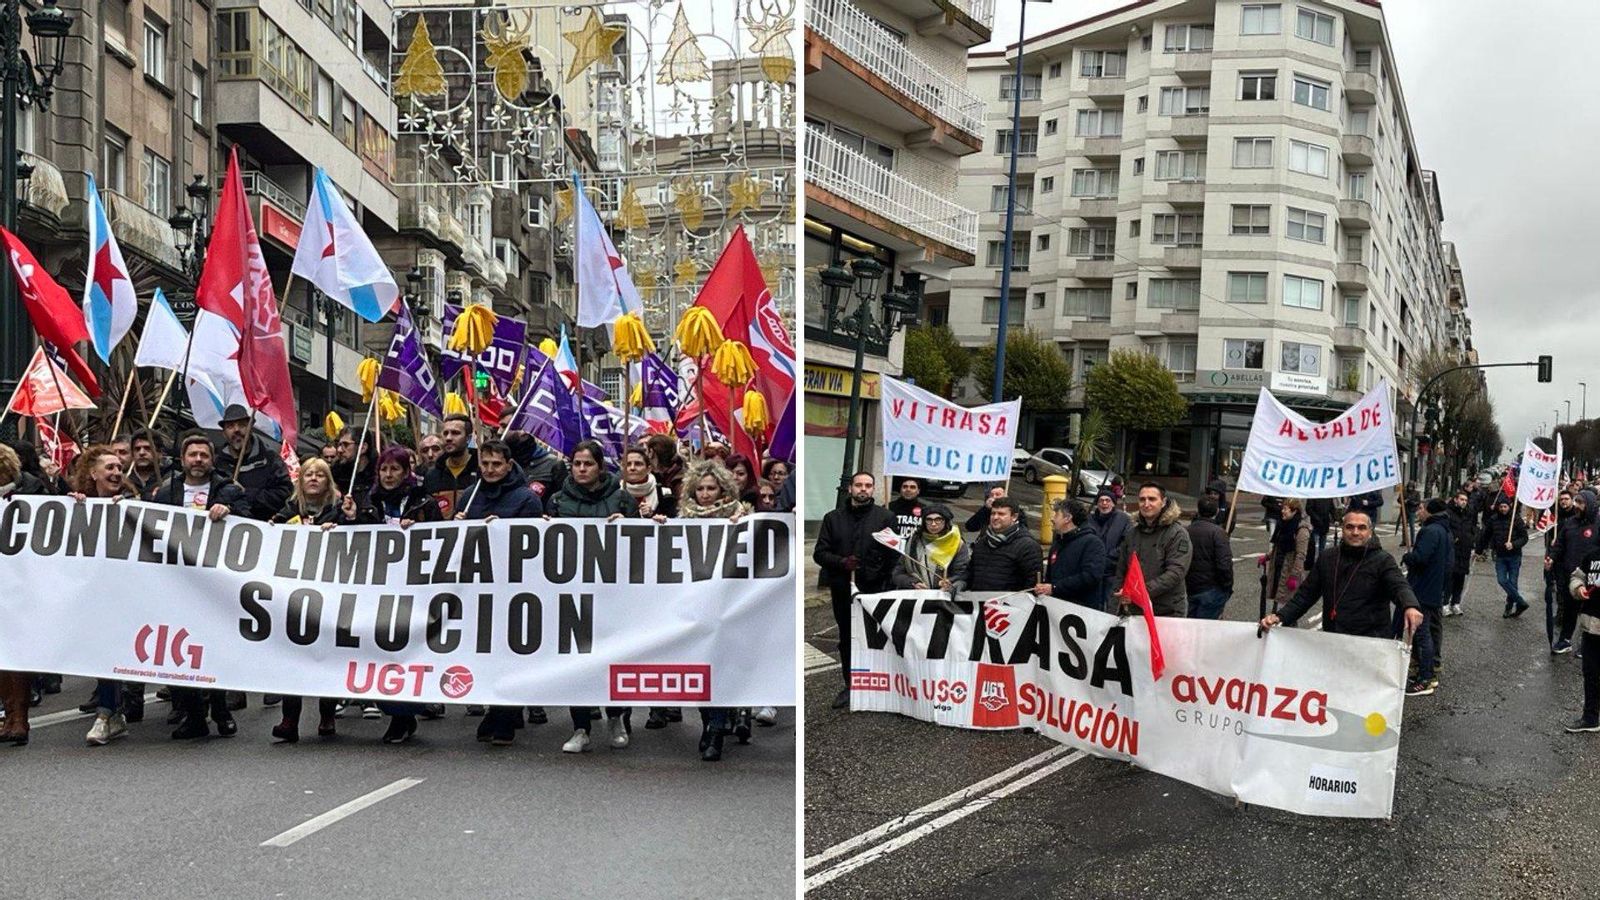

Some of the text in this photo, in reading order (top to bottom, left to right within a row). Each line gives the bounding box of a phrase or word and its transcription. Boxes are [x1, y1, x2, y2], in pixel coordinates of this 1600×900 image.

[893, 398, 1007, 435] VITRASA
[1279, 403, 1381, 441] ALCALDE
[886, 440, 1007, 475] OLUCION
[1261, 455, 1395, 488] COMPLICE
[0, 499, 790, 585] CONVENIO LIMPEZA PONTEVED
[238, 581, 593, 654] SOLUCION
[134, 624, 204, 670] CIG
[859, 598, 1134, 697] VITRASA
[346, 660, 434, 696] UGT
[616, 672, 705, 694] CCOO
[851, 676, 888, 688] CCOO
[982, 680, 1006, 697] UGT
[1171, 673, 1329, 726] avanza
[1175, 709, 1243, 736] GRUPO
[1309, 775, 1357, 794] HORARIOS
